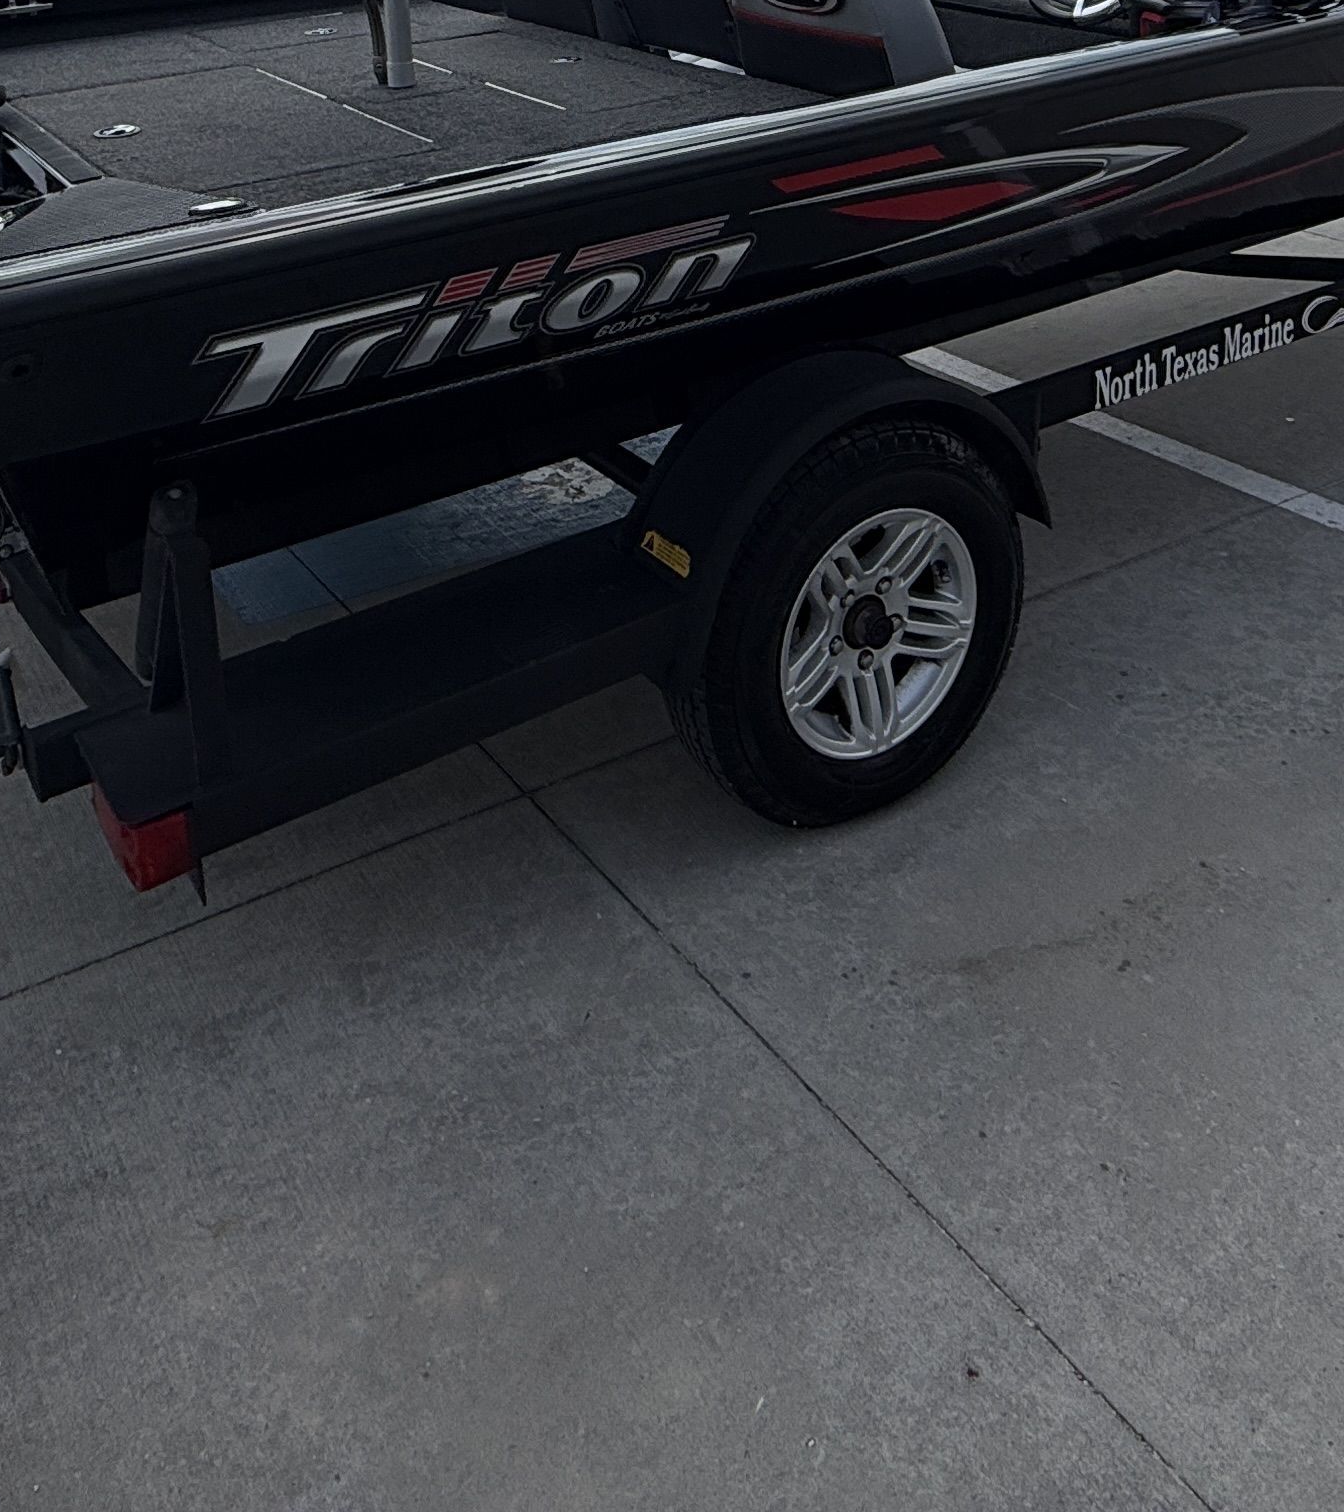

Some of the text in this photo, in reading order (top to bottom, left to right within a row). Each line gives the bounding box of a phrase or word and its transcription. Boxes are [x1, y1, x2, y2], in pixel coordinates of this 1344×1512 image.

[196, 232, 756, 420] Triton
[594, 312, 661, 339] BOATS
[1094, 314, 1295, 410] North Texas Marine
